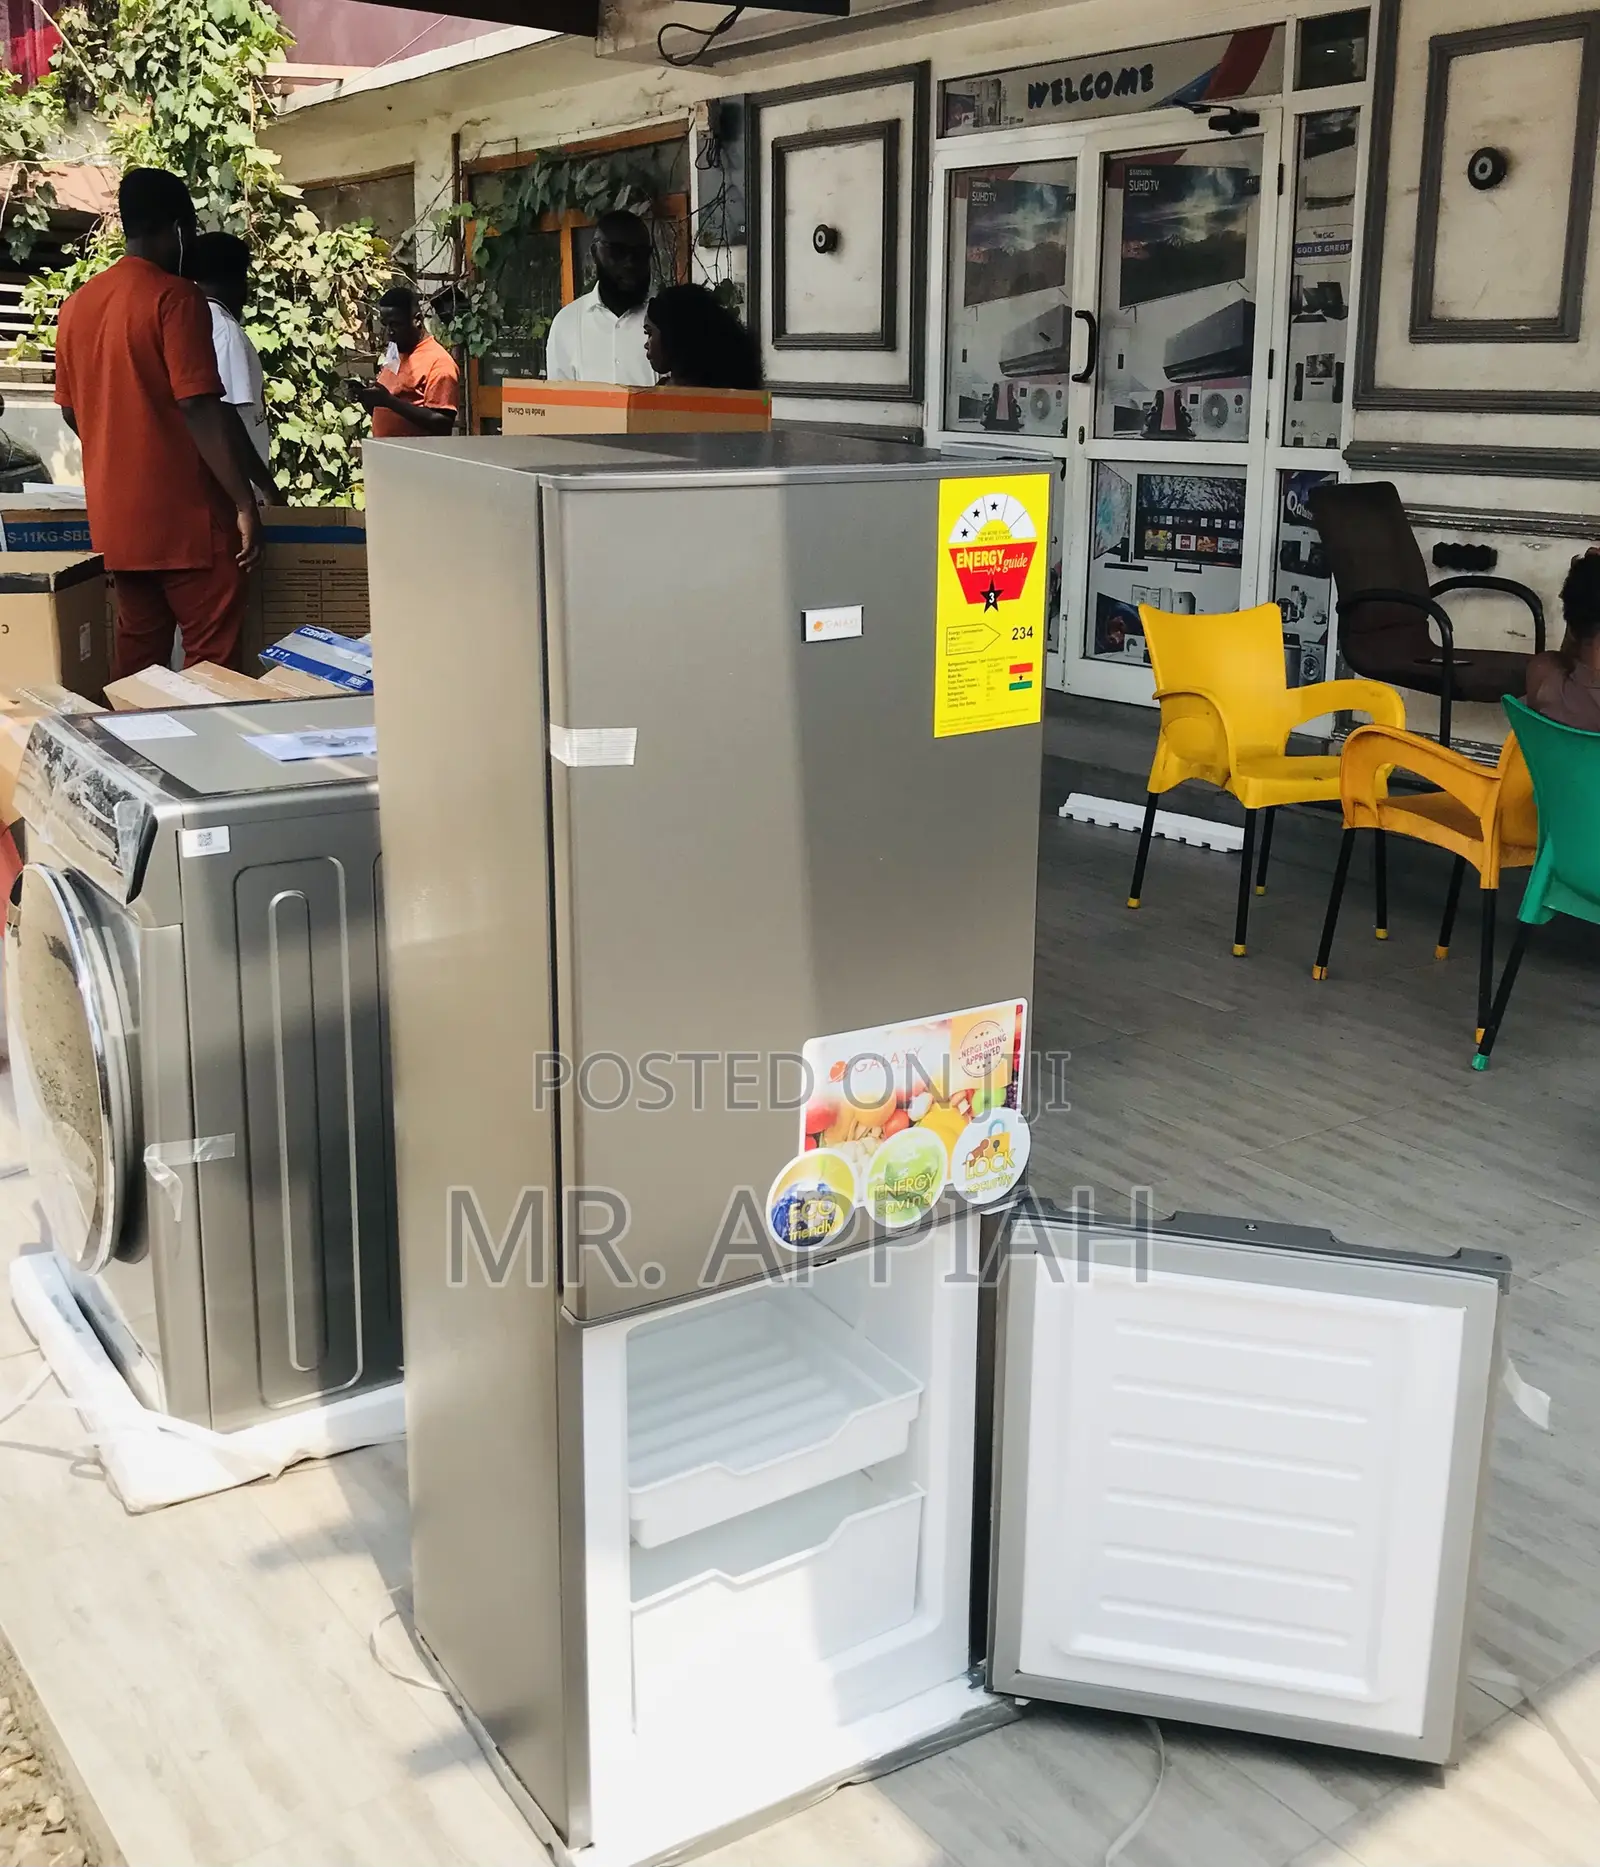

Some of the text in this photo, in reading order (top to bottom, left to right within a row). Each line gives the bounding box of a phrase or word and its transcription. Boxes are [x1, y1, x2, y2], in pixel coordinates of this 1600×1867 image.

[1028, 64, 1154, 109] WELCOME
[1324, 244, 1350, 252] GREAT
[956, 549, 1028, 574] ENERGY guide
[988, 592, 995, 603] 3
[1012, 625, 1034, 641] 234
[984, 1033, 1007, 1049] RATING
[966, 1046, 1001, 1067] APPROVED
[966, 1148, 1016, 1180] LOCK
[875, 1171, 938, 1201] ENERGY
[966, 1173, 1014, 1194] security
[788, 1194, 836, 1224] ECO
[876, 1190, 933, 1216] saving
[788, 1220, 835, 1242] friendly
